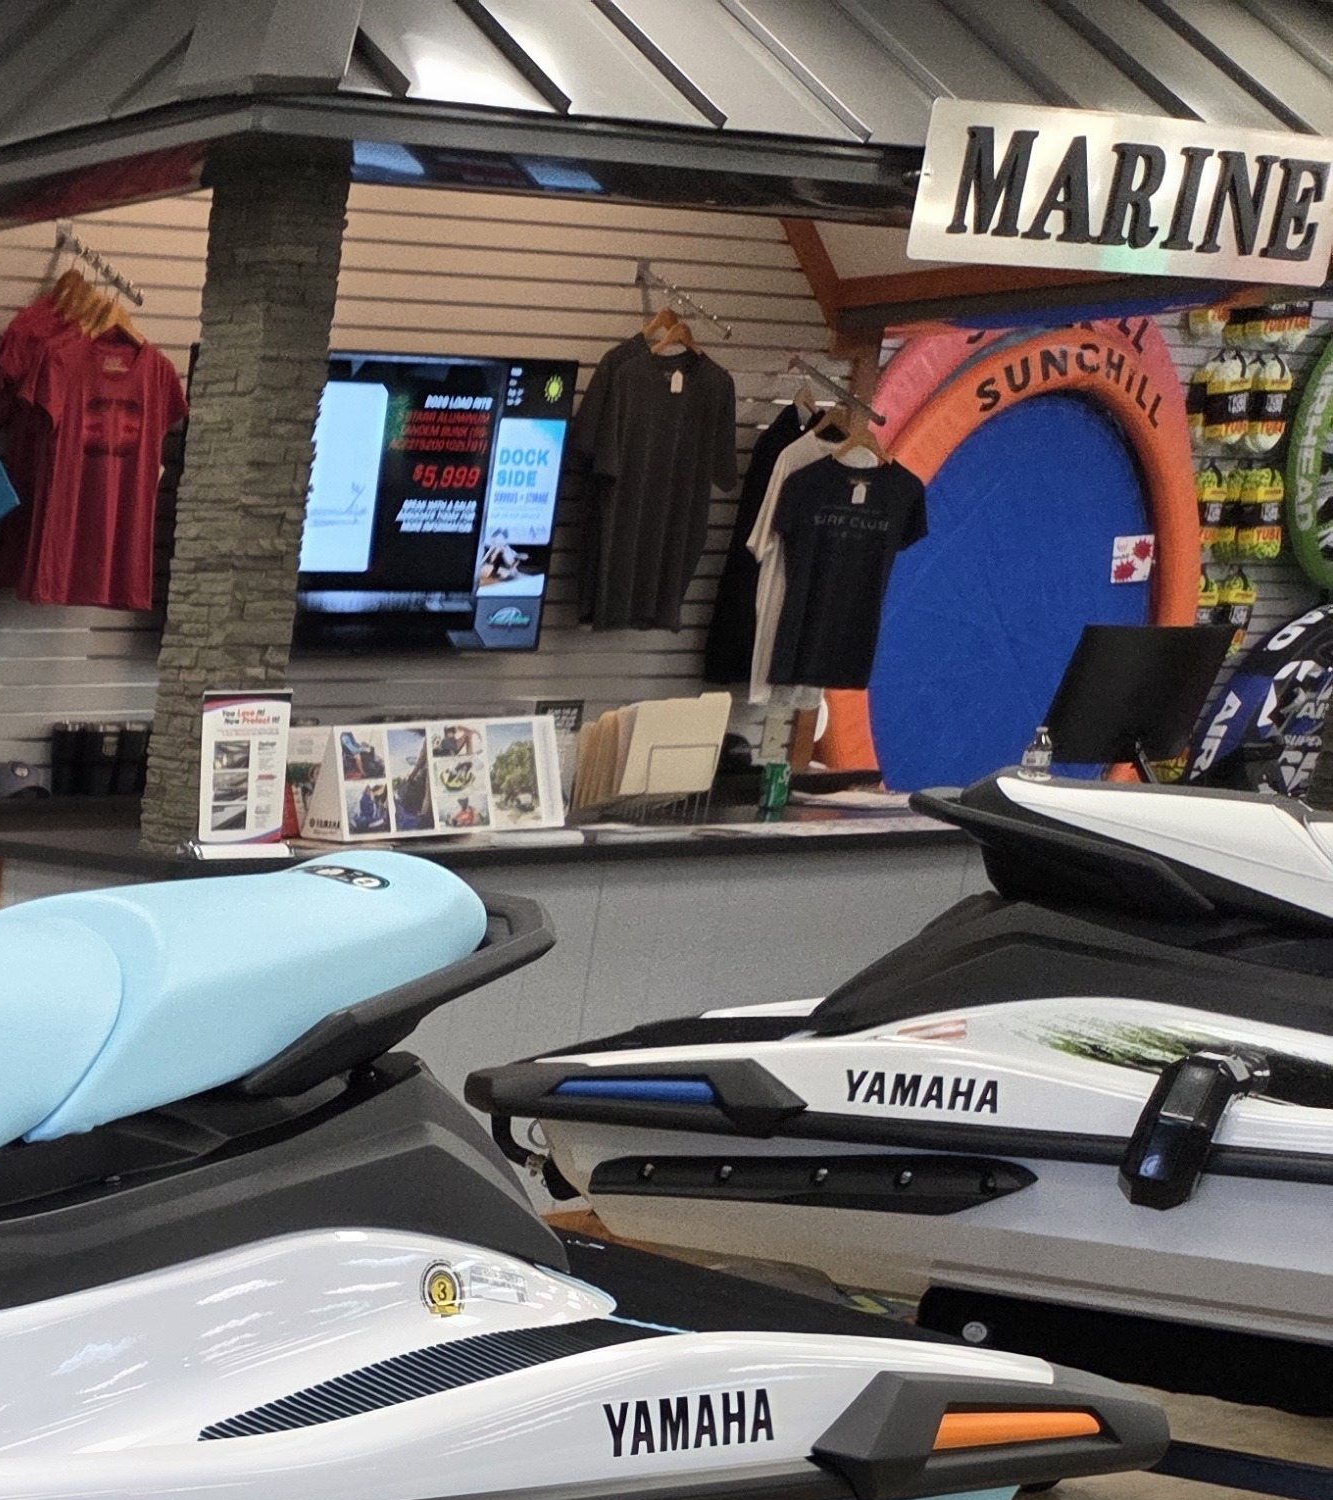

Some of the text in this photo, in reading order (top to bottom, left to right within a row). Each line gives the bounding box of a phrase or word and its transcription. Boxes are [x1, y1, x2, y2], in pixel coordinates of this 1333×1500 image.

[946, 125, 1331, 261] MARINE
[976, 343, 1162, 429] SUNCHILL
[496, 470, 538, 487] SIDE
[499, 450, 550, 467] DOCK
[846, 1069, 999, 1114] YAMAHA
[602, 1388, 774, 1458] YAMAHA
